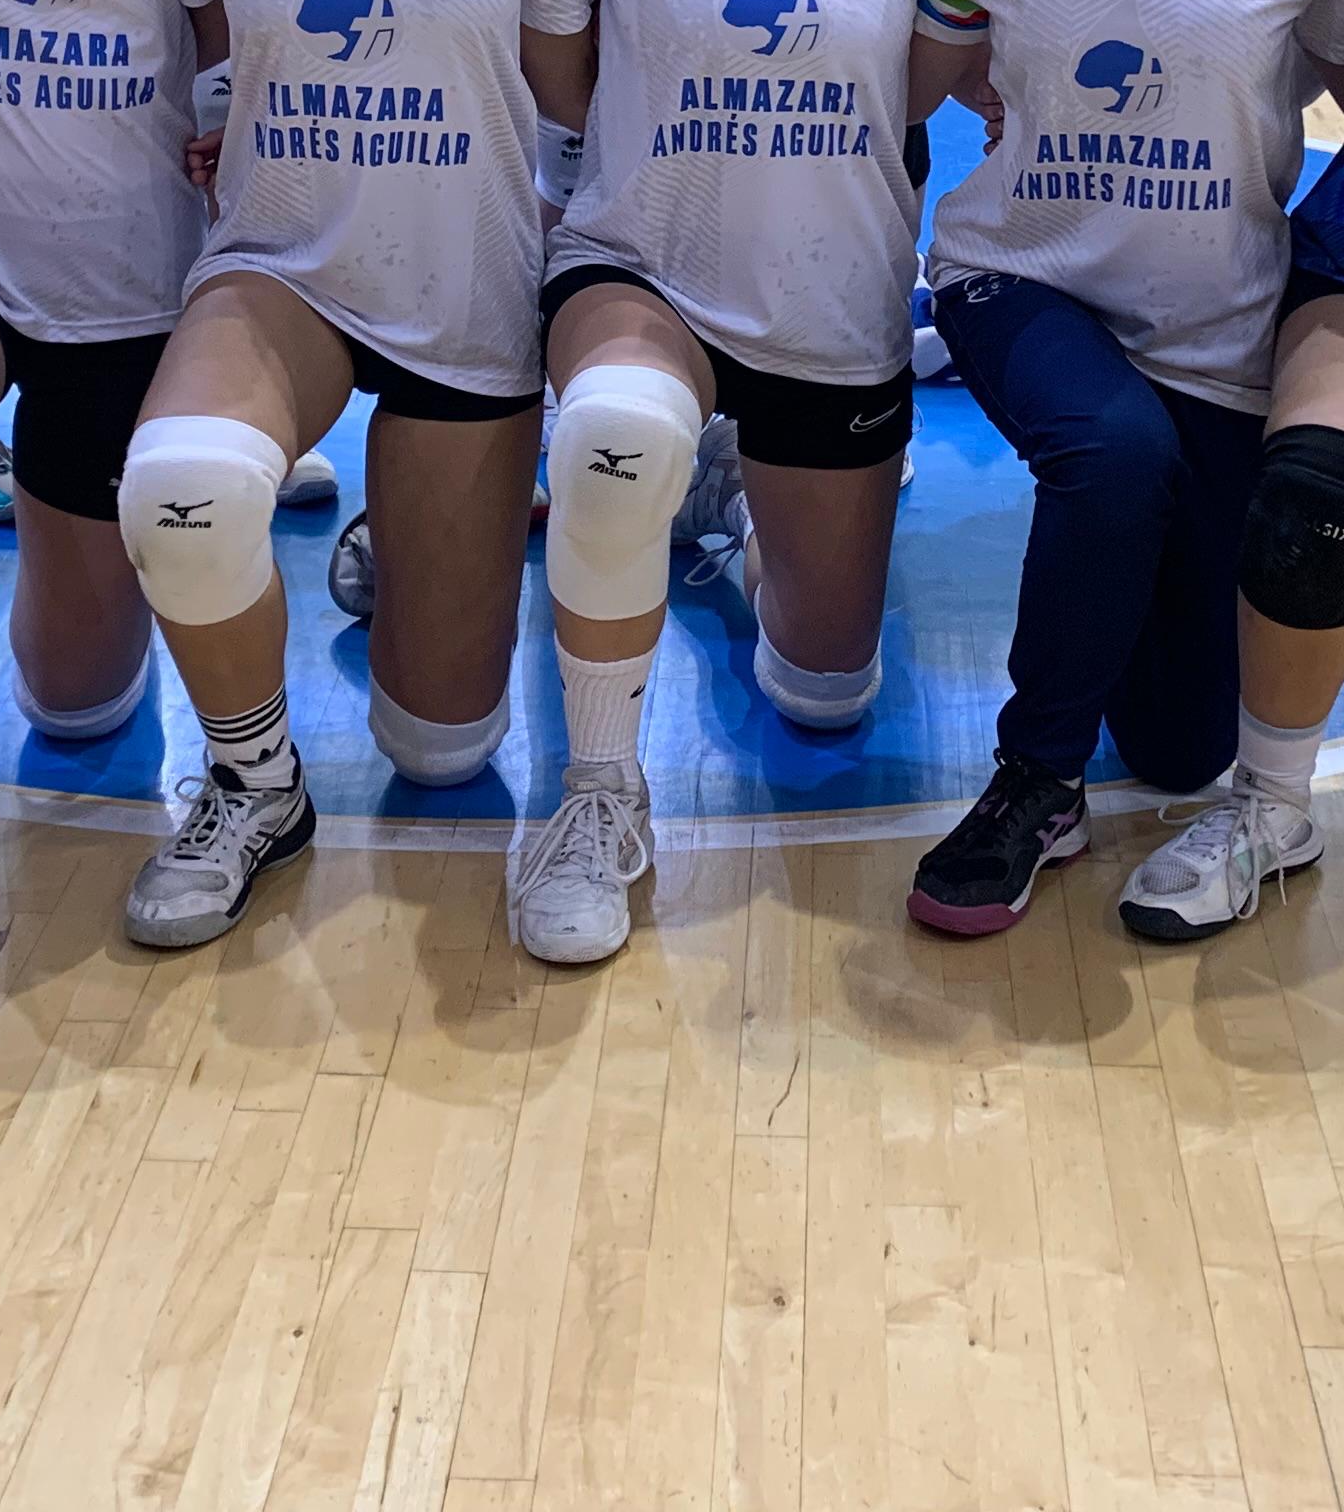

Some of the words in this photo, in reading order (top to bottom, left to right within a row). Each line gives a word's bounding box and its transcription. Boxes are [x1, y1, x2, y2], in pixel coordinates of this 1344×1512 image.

[34, 74, 155, 110] AGUILAR
[351, 131, 470, 167] AGUILAR
[651, 114, 757, 158] ANDRÉS
[770, 122, 873, 158] AGUILA
[1037, 134, 1212, 171] ALMAZARA
[1012, 165, 1114, 203] ANDRÉS
[1122, 176, 1232, 211] AGUILAR
